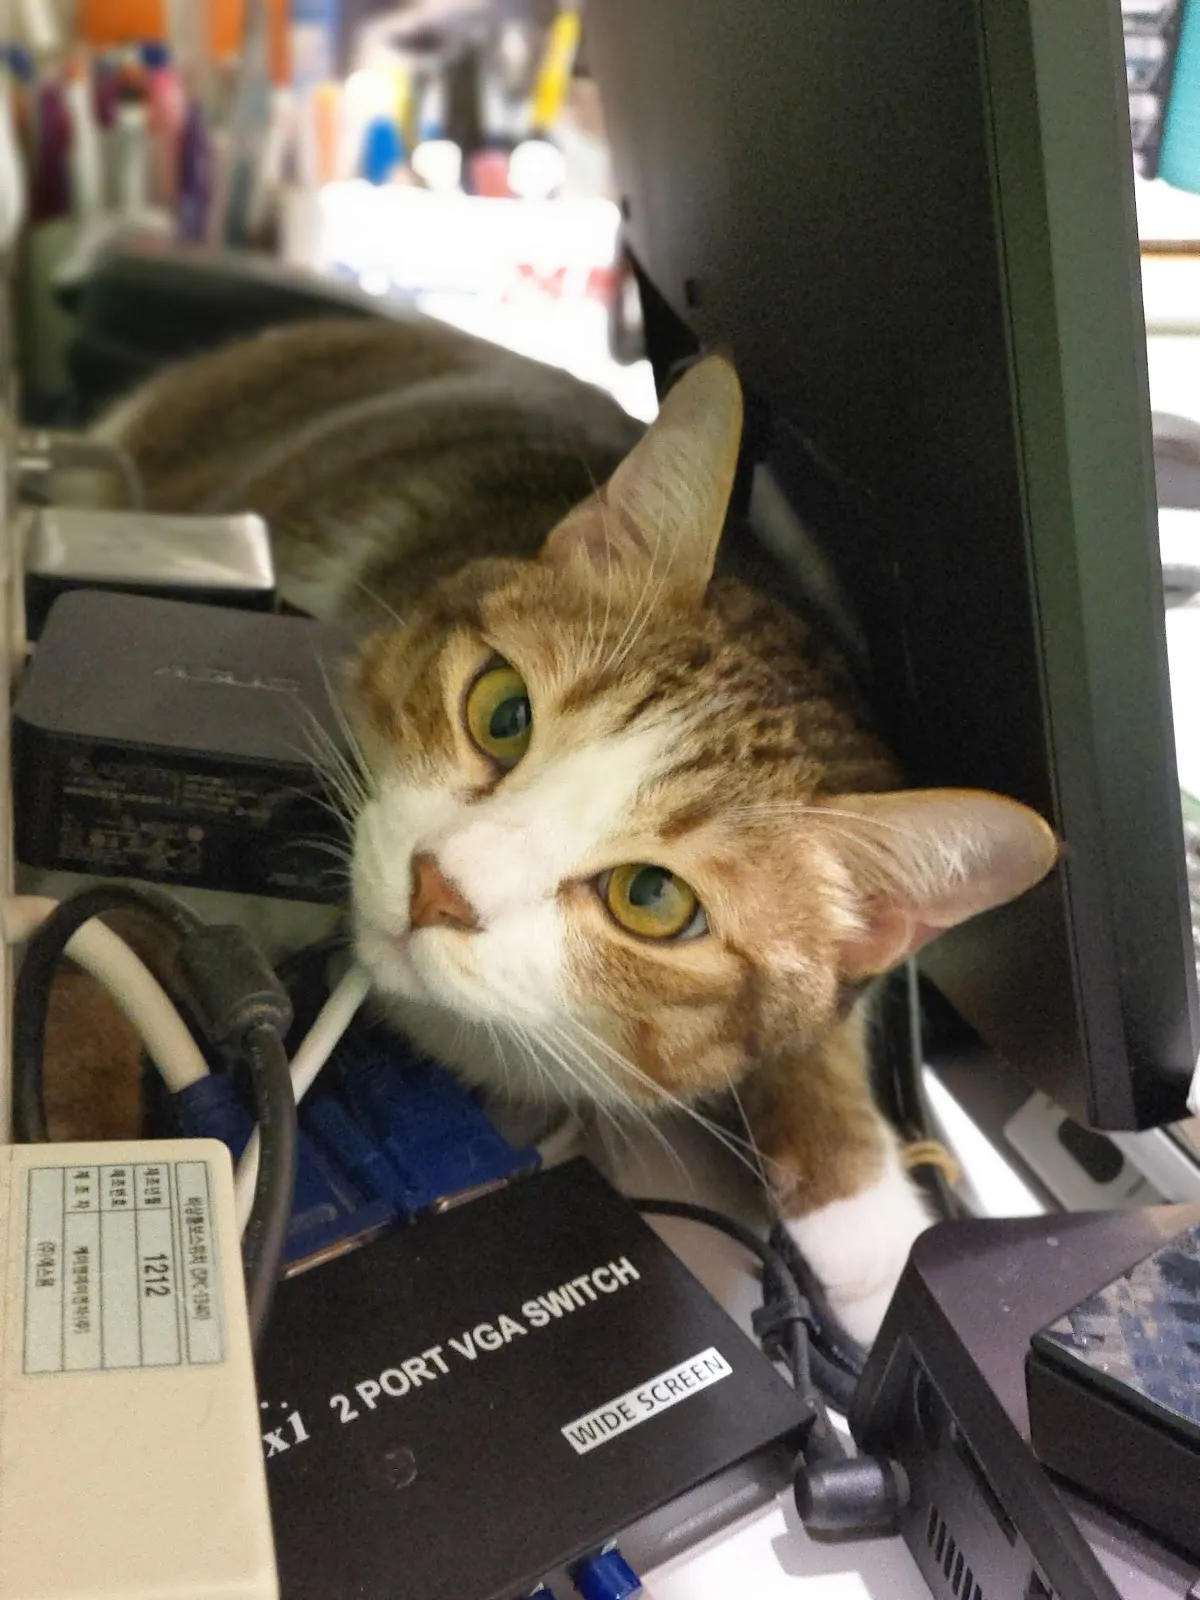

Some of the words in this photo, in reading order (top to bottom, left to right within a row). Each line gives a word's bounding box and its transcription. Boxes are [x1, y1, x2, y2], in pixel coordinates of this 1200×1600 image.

[109, 1169, 128, 1207] 제조번호
[144, 1167, 162, 1205] 제조년월
[144, 1253, 171, 1298] 1212
[330, 1392, 359, 1424] 2
[356, 1345, 450, 1410] PORT
[449, 1314, 528, 1361] VGA
[522, 1256, 641, 1328] SWITCH
[568, 1403, 637, 1448] WIDE
[638, 1355, 725, 1412] SCREEN
